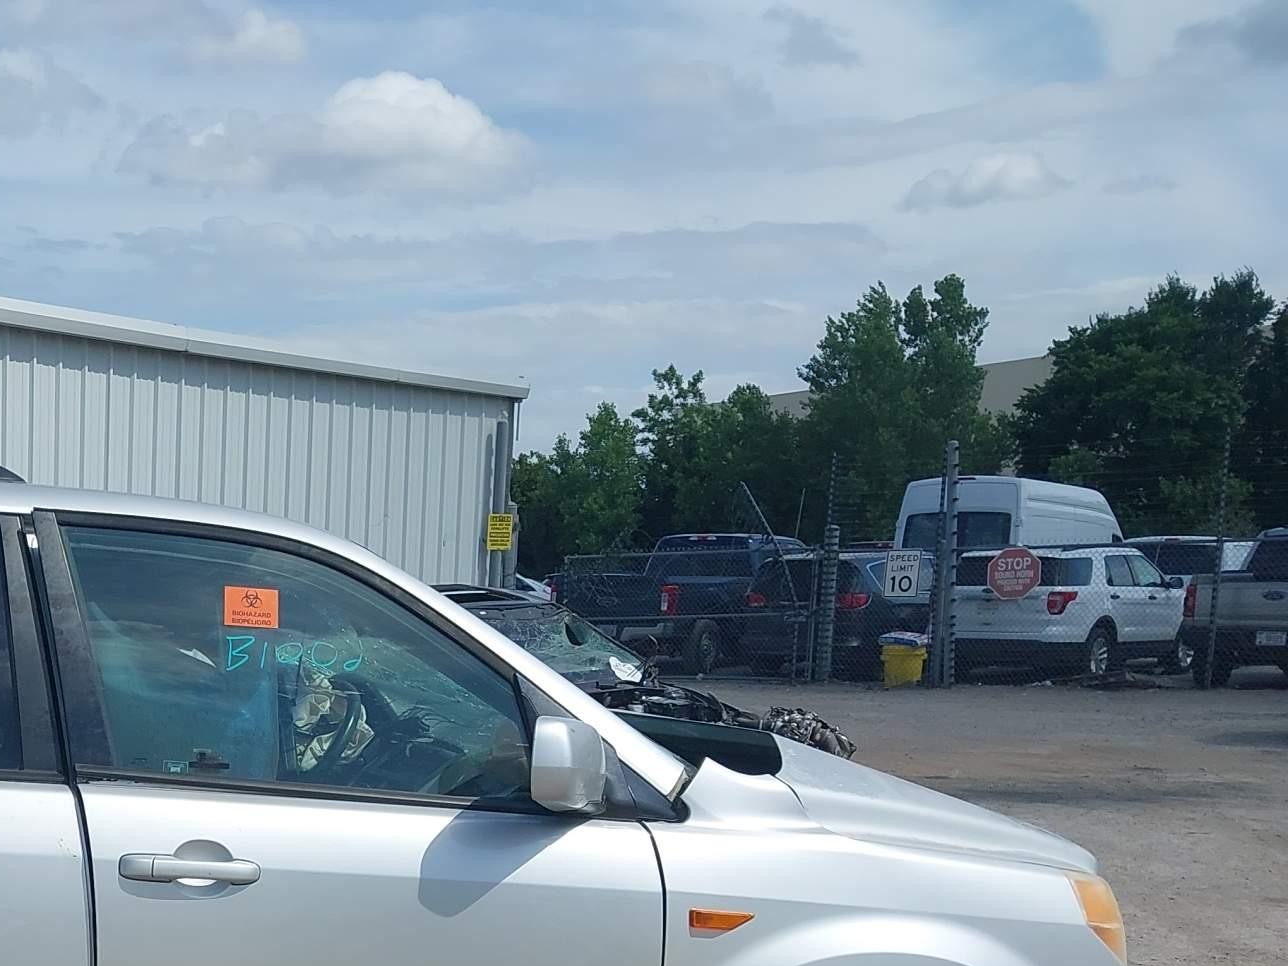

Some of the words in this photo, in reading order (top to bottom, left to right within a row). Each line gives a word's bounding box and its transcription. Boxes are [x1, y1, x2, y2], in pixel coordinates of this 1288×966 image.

[889, 554, 919, 562] SPEED
[891, 564, 914, 572] LIMIT
[997, 557, 1032, 571] STOP
[890, 575, 913, 593] 10
[232, 609, 272, 619] BIOHAZARD
